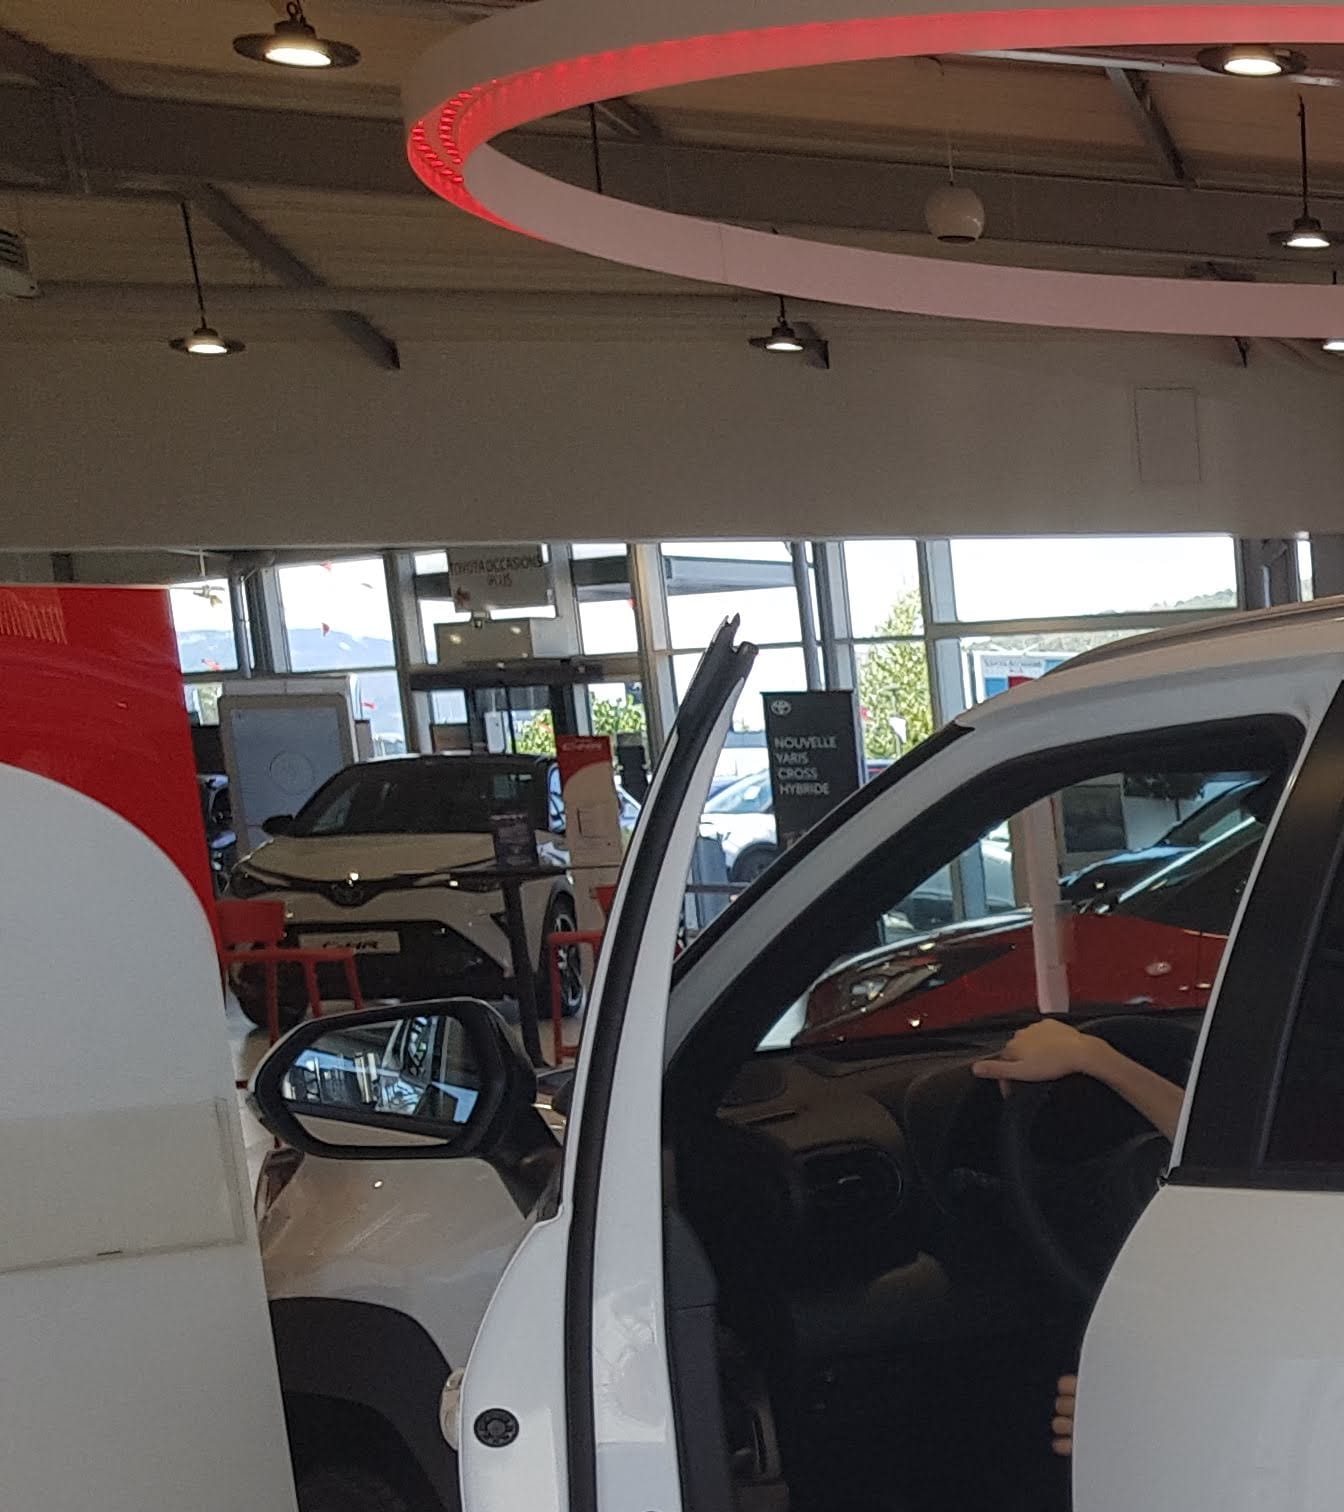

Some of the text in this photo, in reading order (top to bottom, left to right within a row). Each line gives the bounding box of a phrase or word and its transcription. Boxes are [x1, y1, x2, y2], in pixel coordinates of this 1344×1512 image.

[773, 736, 837, 750] NOUVELLE
[775, 751, 809, 765] YARIS
[777, 766, 818, 781] CROSS
[779, 781, 832, 796] HYBRIDE
